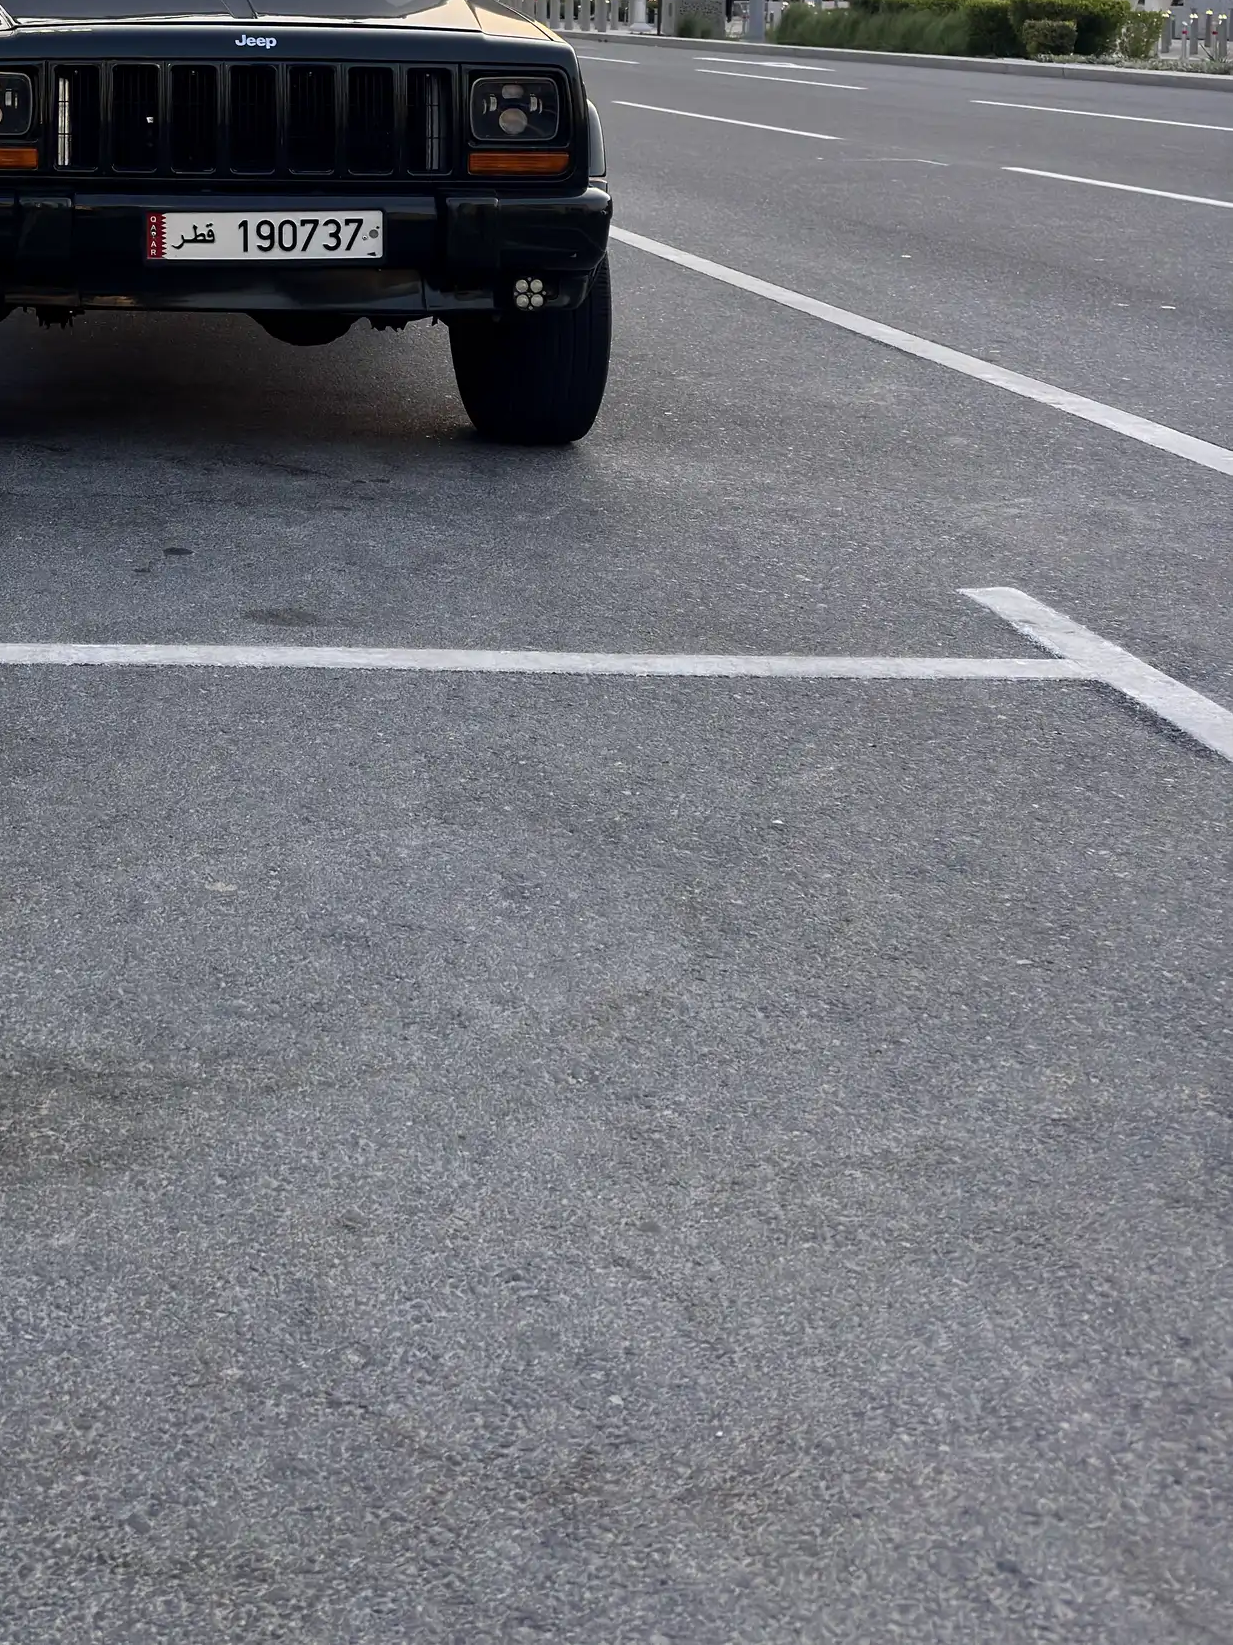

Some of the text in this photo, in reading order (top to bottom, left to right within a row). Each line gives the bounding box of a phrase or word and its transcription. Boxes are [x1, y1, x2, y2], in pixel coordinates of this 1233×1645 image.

[234, 34, 277, 50] Jeep
[149, 215, 158, 256] QAAR
[171, 222, 216, 250] قطر
[237, 218, 364, 253] 190737
